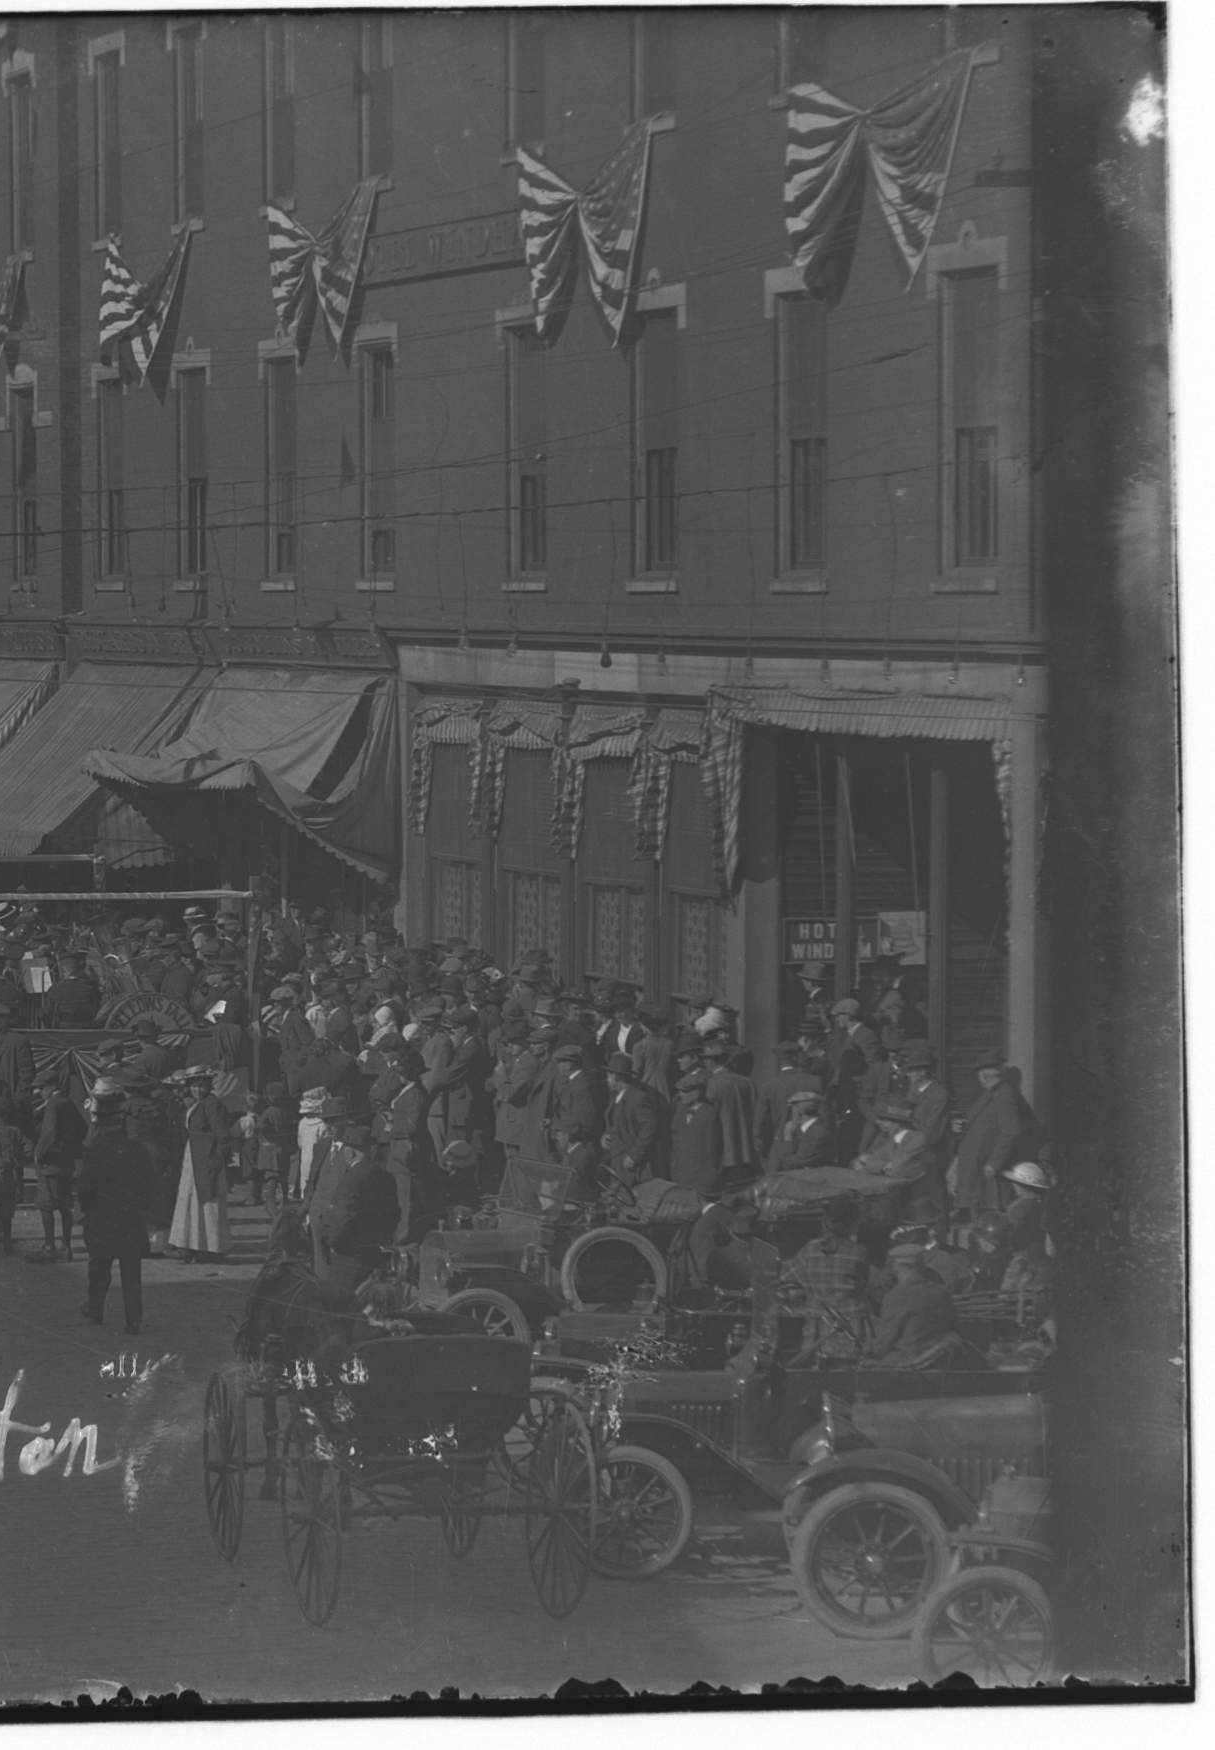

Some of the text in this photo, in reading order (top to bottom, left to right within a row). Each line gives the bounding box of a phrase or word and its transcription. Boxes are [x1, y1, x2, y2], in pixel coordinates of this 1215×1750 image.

[362, 215, 526, 278] OTEL WINDHA
[798, 922, 837, 940] HOT
[791, 942, 873, 959] WINDM
[164, 1000, 194, 1030] FALL
